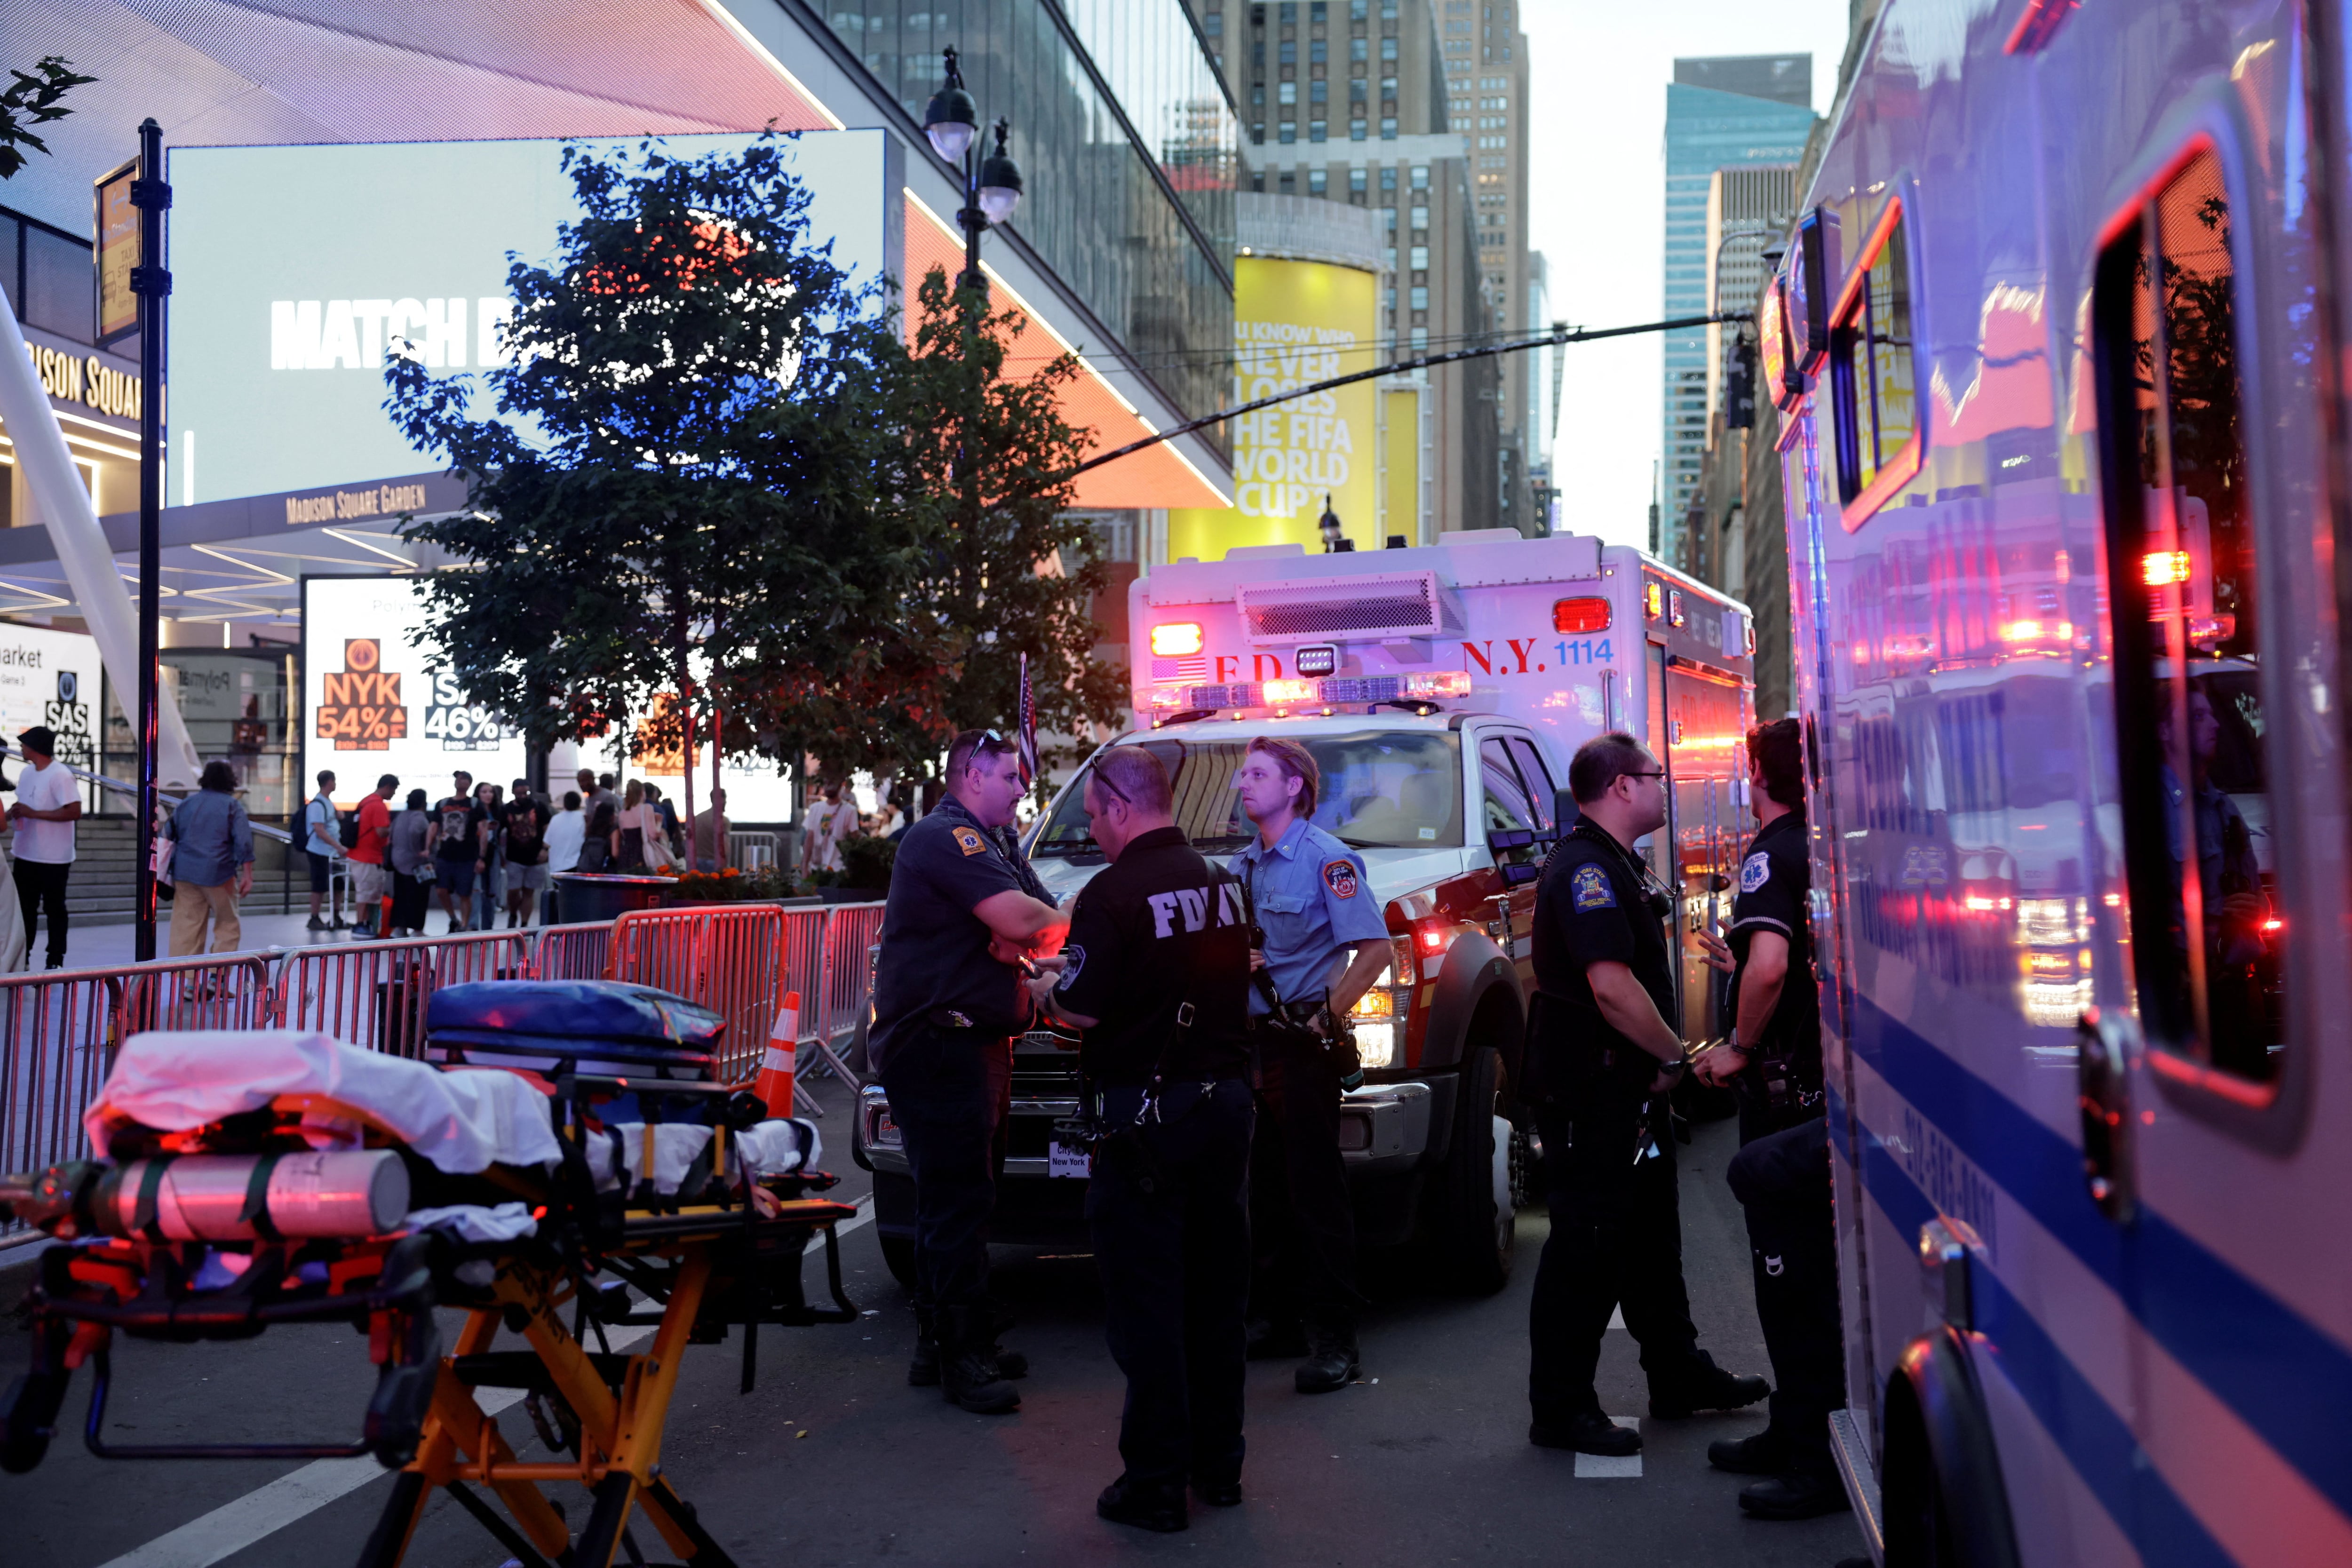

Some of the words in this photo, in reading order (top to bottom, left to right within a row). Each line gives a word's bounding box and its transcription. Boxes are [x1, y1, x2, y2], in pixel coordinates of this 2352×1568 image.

[120, 244, 135, 263] TAXI
[271, 298, 467, 369] MATCH
[1252, 322, 1311, 342] KNOW
[1316, 326, 1355, 349] WHO
[1234, 341, 1340, 381] NEVER
[1234, 375, 1337, 415] LOSES
[1234, 411, 1282, 446] HE
[1290, 414, 1352, 453] FIFA
[1234, 447, 1350, 486] WORLD
[286, 495, 335, 525] MADISON
[336, 490, 380, 519] SQUARE
[381, 484, 426, 514] GARDEN
[0, 644, 42, 669] arket
[1554, 638, 1614, 665] 1114
[325, 673, 401, 705] NYK
[47, 701, 87, 734] SAS
[318, 707, 389, 739] 54%
[426, 706, 499, 739] 46%
[54, 733, 81, 764] 6%
[1593, 868, 1605, 879] STATE
[1757, 875, 1766, 884] UNIT
[1057, 1146, 1071, 1156] City
